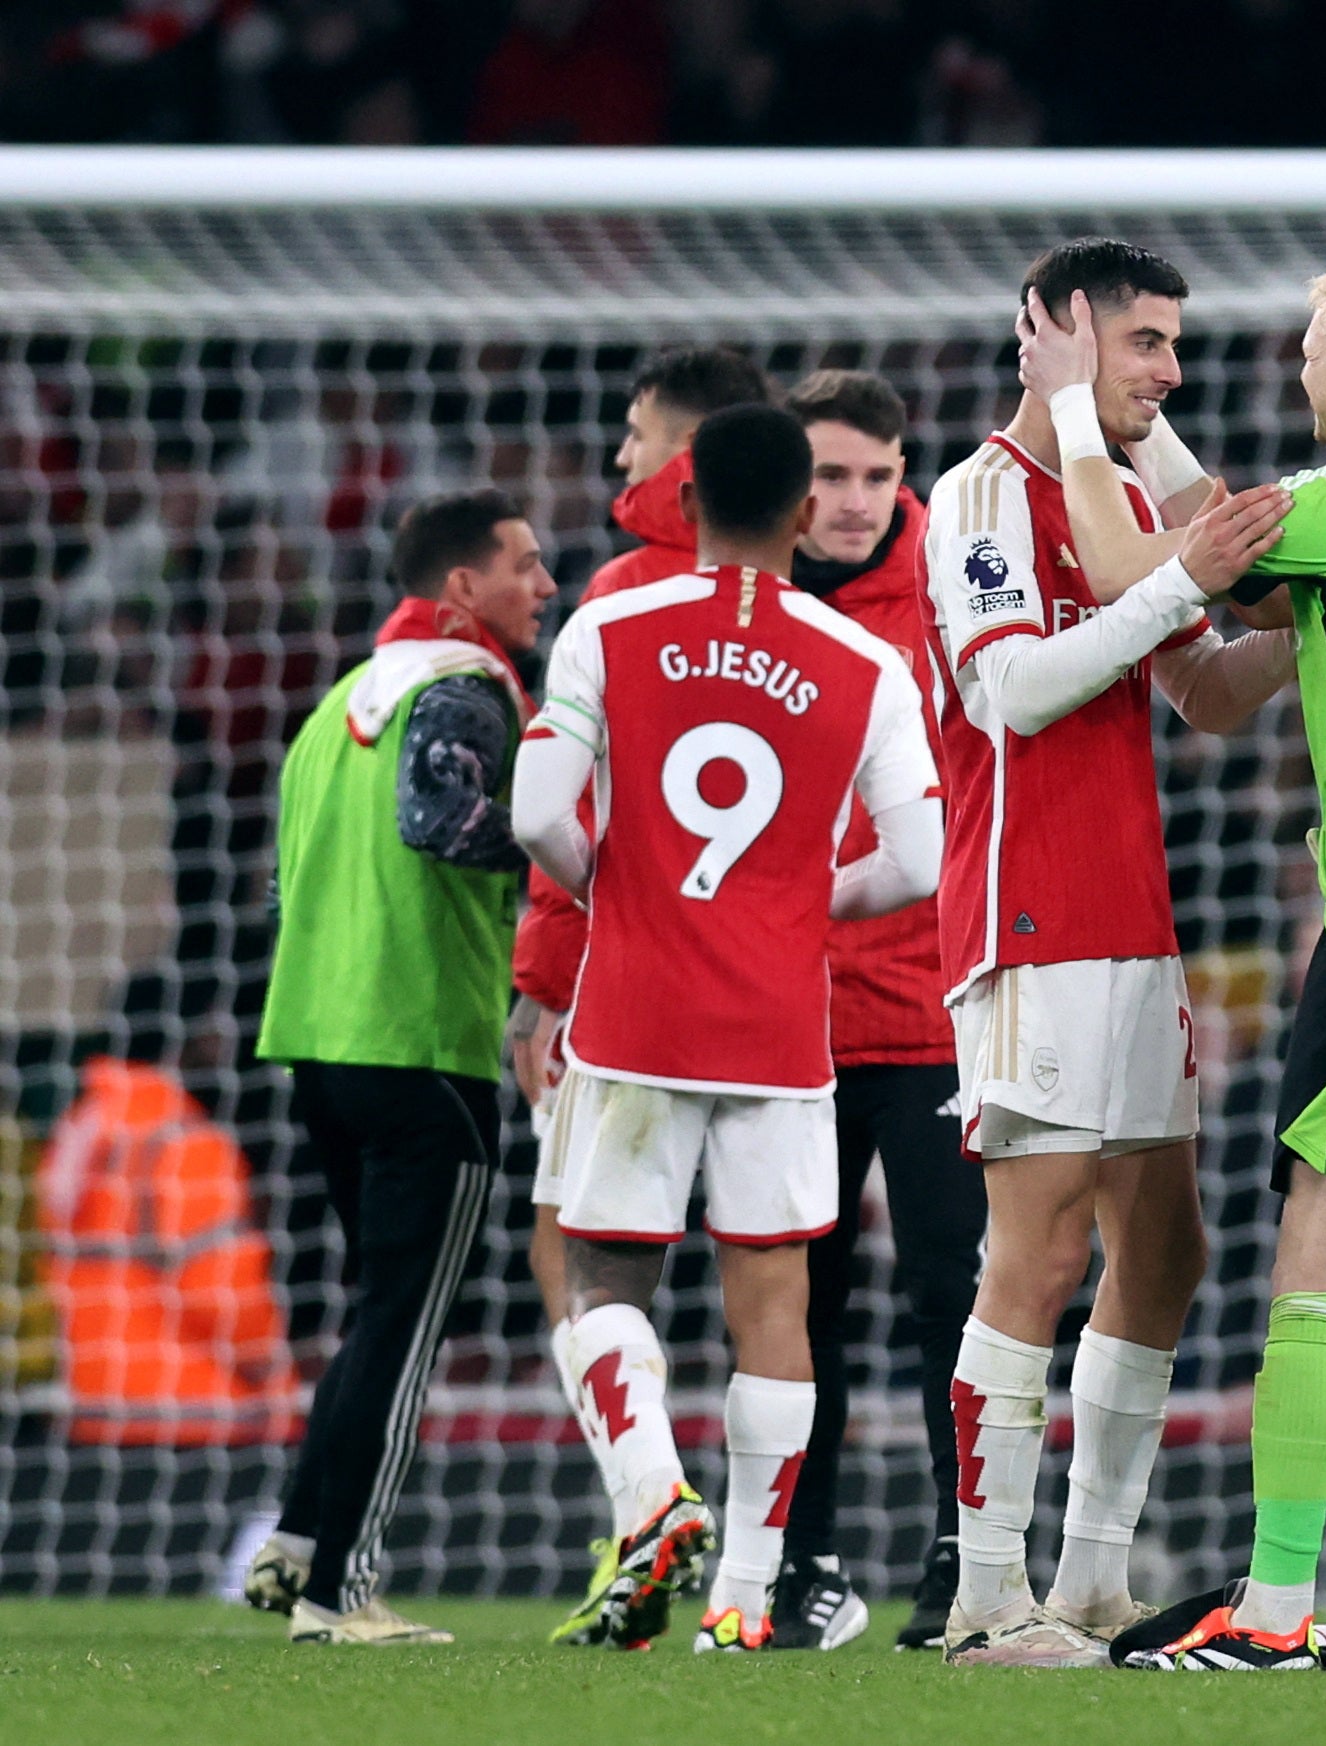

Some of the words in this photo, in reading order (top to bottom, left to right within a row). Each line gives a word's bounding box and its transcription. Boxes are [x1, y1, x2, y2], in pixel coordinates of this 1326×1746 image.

[984, 591, 1020, 604] room
[659, 639, 820, 716] G.JESUS
[661, 721, 784, 901] 9
